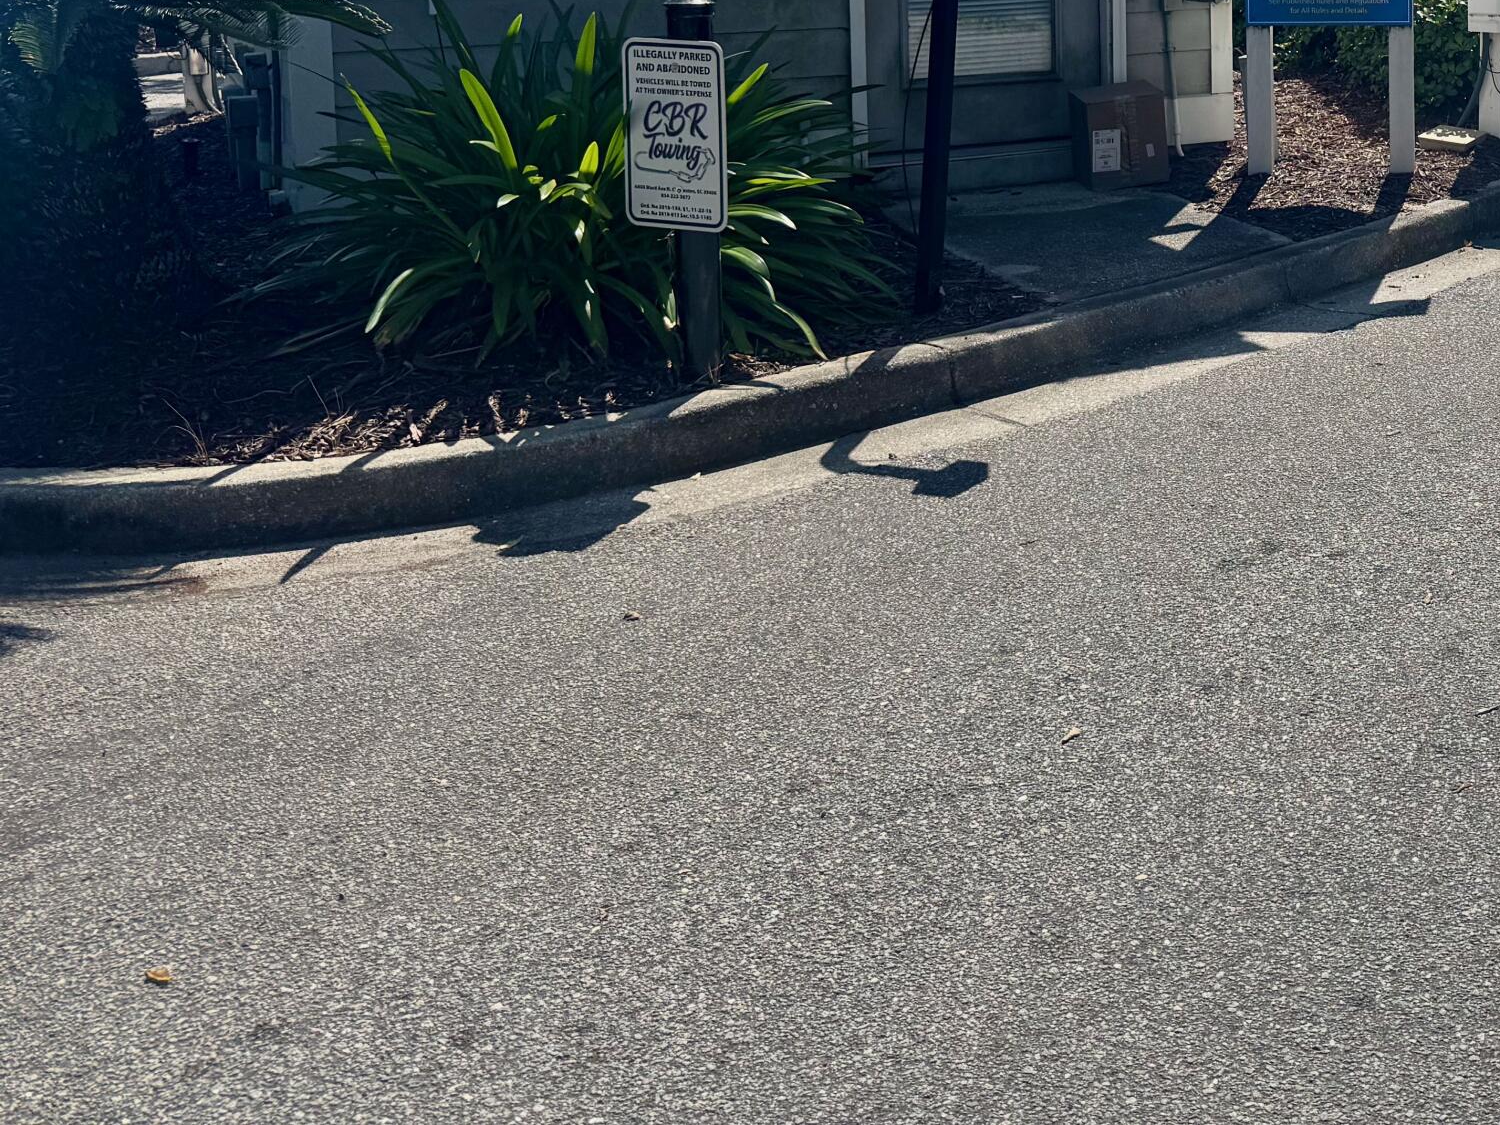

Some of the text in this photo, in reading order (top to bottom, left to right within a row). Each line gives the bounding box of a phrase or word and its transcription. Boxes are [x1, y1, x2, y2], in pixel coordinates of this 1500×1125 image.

[634, 50, 712, 61] ILLEGALLY PARKED
[636, 63, 710, 75] AND ABADONED
[686, 90, 712, 98] EXPENSE
[644, 101, 708, 140] CBR
[643, 132, 702, 170] Towing
